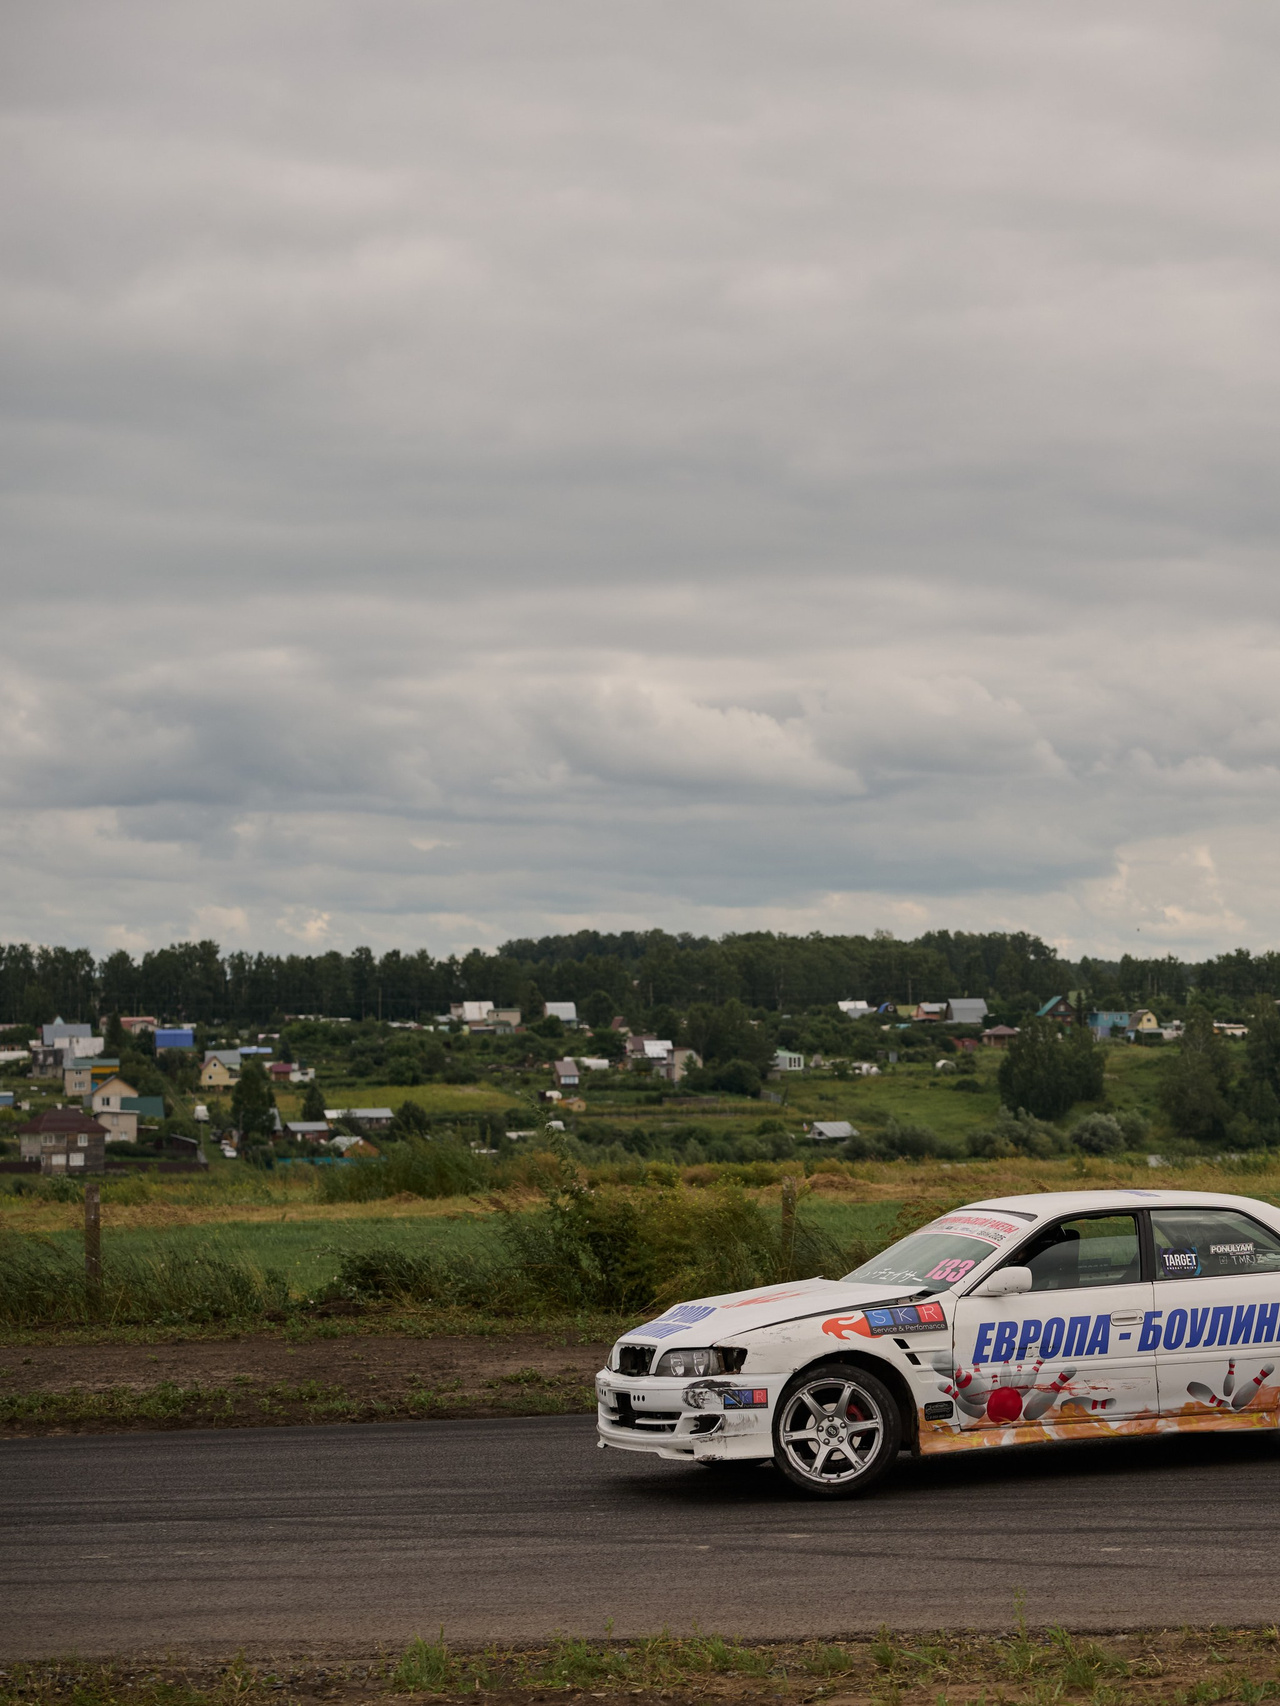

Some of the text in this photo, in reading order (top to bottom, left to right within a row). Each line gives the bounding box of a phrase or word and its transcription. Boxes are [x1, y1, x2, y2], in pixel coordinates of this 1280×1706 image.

[1163, 1253, 1198, 1267] TARGET
[924, 1258, 976, 1283] 133
[872, 1325, 898, 1334] Service
[971, 1314, 1112, 1364] ЕВРОПА
